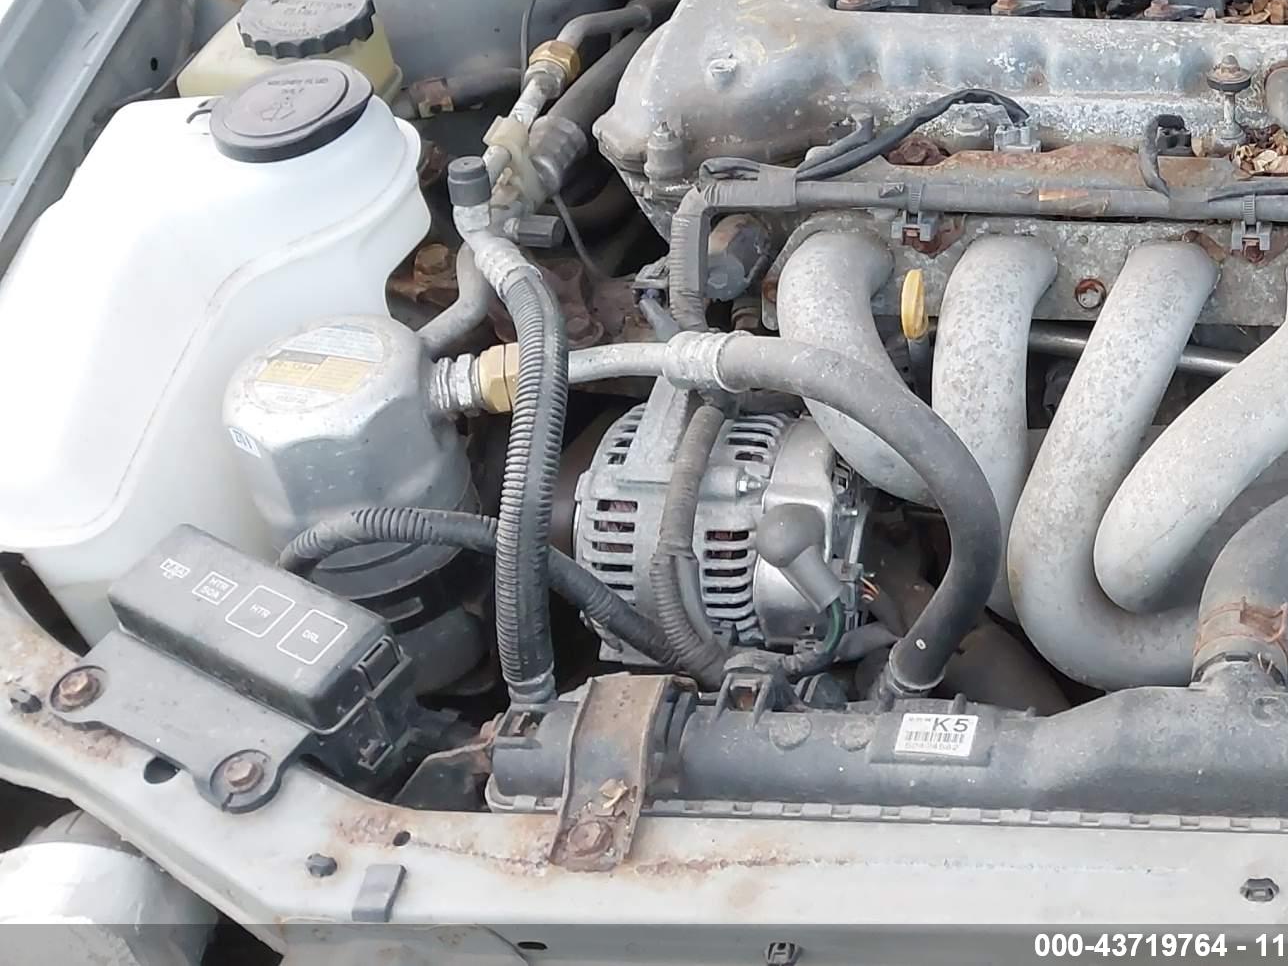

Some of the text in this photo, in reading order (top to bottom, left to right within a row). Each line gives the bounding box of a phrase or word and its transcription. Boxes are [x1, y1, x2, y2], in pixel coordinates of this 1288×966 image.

[249, 603, 271, 619] HTR
[301, 628, 320, 644] DRL
[932, 717, 969, 733] K5
